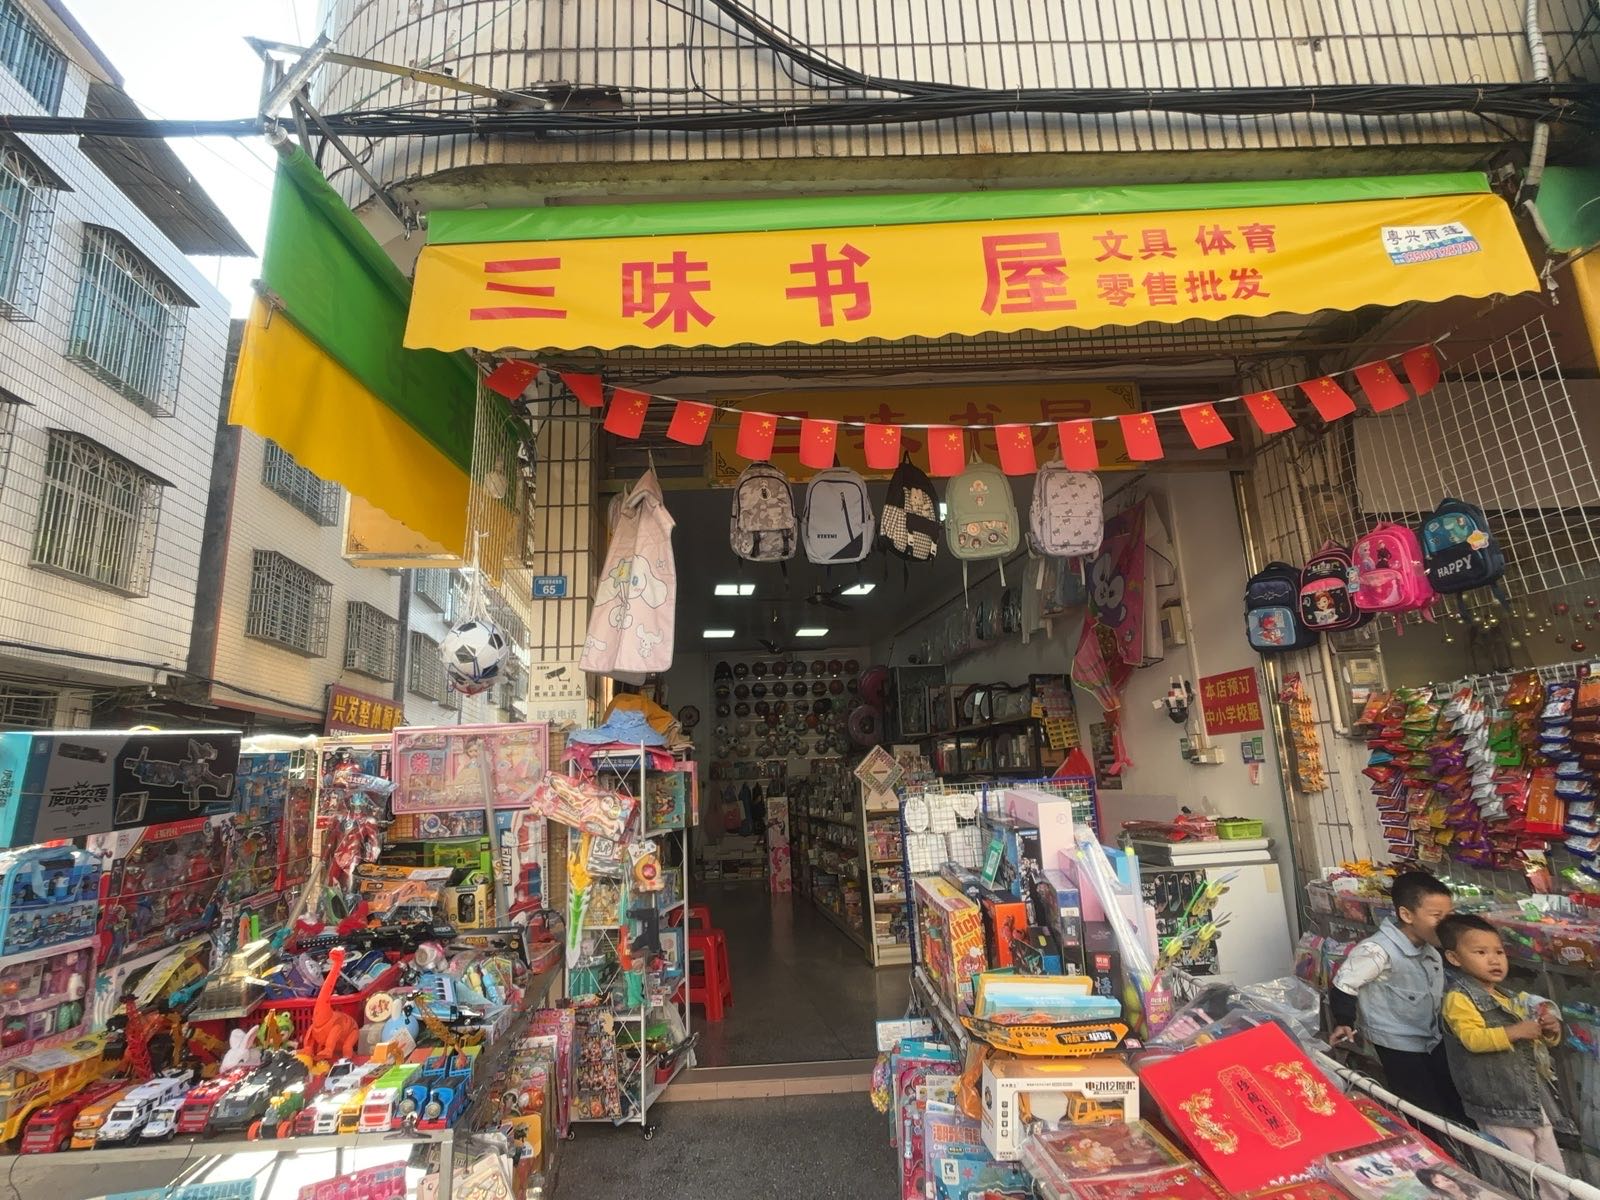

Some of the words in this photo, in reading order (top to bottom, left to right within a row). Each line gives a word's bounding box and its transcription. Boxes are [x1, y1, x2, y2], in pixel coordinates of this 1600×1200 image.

[1091, 228, 1177, 263] 文具
[1195, 222, 1277, 260] 体育
[470, 231, 1077, 332] 三味书屋
[1096, 267, 1271, 308] 零售批发
[1437, 554, 1473, 578] HAPPY
[543, 585, 556, 595] 65
[1205, 675, 1250, 701] 本店预订
[1205, 702, 1261, 727] 中小学校服
